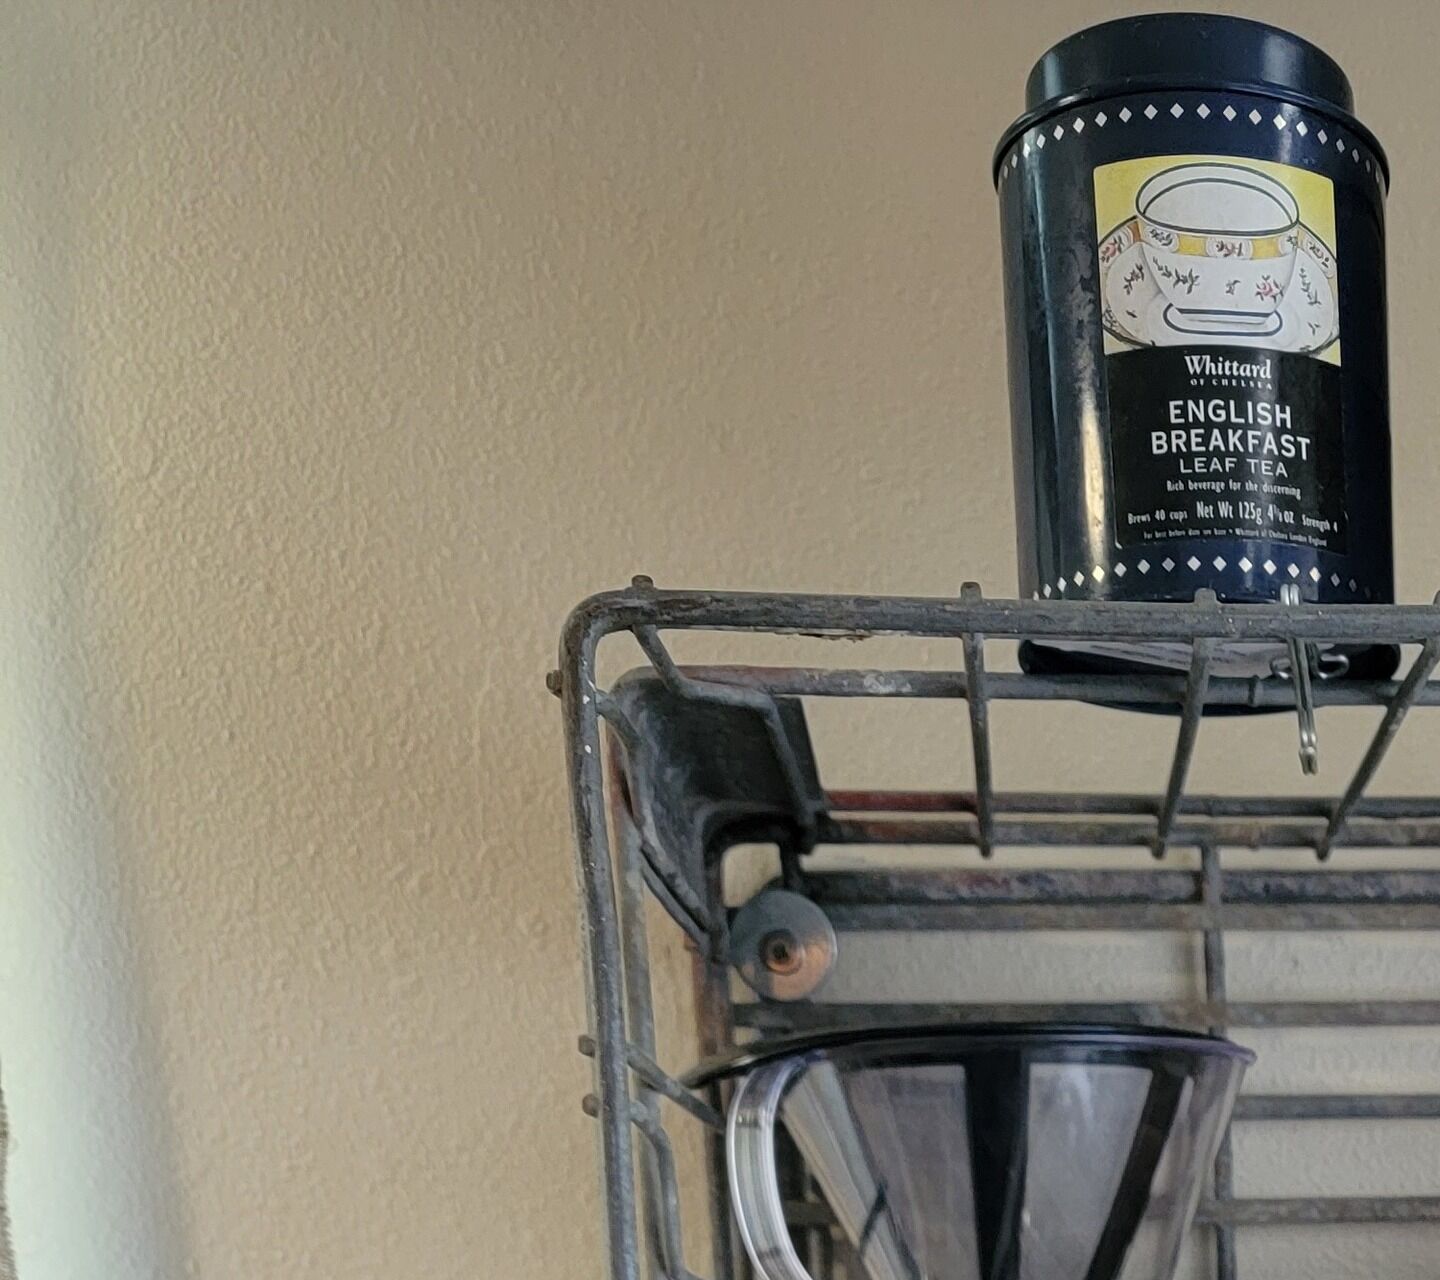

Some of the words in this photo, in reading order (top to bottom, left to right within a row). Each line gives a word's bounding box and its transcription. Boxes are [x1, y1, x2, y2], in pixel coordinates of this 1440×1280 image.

[1184, 355, 1272, 379] Whittard
[1212, 378, 1273, 390] CHELSEA
[1168, 399, 1292, 429] ENGLISH
[1150, 428, 1311, 461] BREAKFAST
[1179, 457, 1238, 474] LEAF
[1246, 457, 1289, 478] TEA
[1166, 479, 1185, 492] Rich
[1188, 479, 1225, 493] beverage
[1229, 478, 1242, 491] for
[1245, 479, 1259, 492] the
[1262, 480, 1301, 500] discerning
[1127, 512, 1151, 525] Brews
[1169, 508, 1188, 523] cups
[1196, 501, 1214, 519] Net
[1217, 501, 1234, 519] Wt
[1238, 502, 1262, 525] 125g
[1302, 513, 1331, 533] Strength
